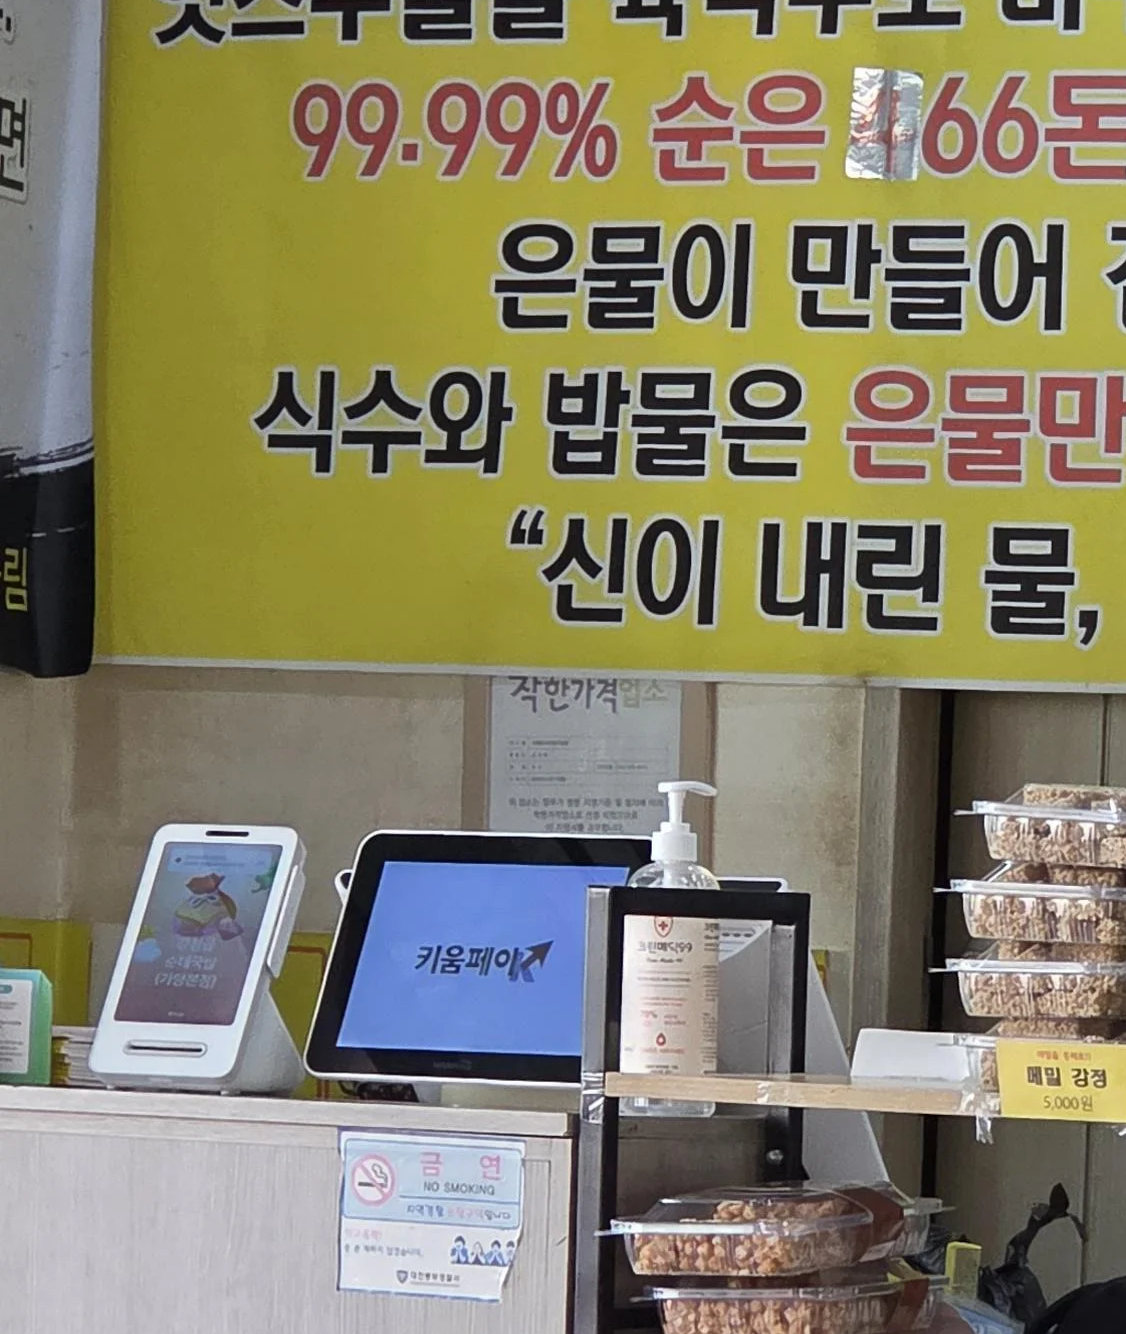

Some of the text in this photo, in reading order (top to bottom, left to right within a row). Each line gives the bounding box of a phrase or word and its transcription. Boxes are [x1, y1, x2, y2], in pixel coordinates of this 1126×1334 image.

[299, 85, 614, 174] 99.99%
[655, 77, 824, 179] 순은
[495, 224, 750, 328] 은물이
[792, 224, 1063, 330] 만들어
[255, 371, 512, 473] 식수와
[547, 370, 806, 476] 밥물은
[761, 522, 941, 630] 내린
[985, 528, 1098, 644] 물,
[1027, 1066, 1107, 1089] 메밀 강정
[1044, 1095, 1094, 1112] 5,000원
[420, 1151, 502, 1181] 금 연
[424, 1182, 495, 1195] NO SMOKING
